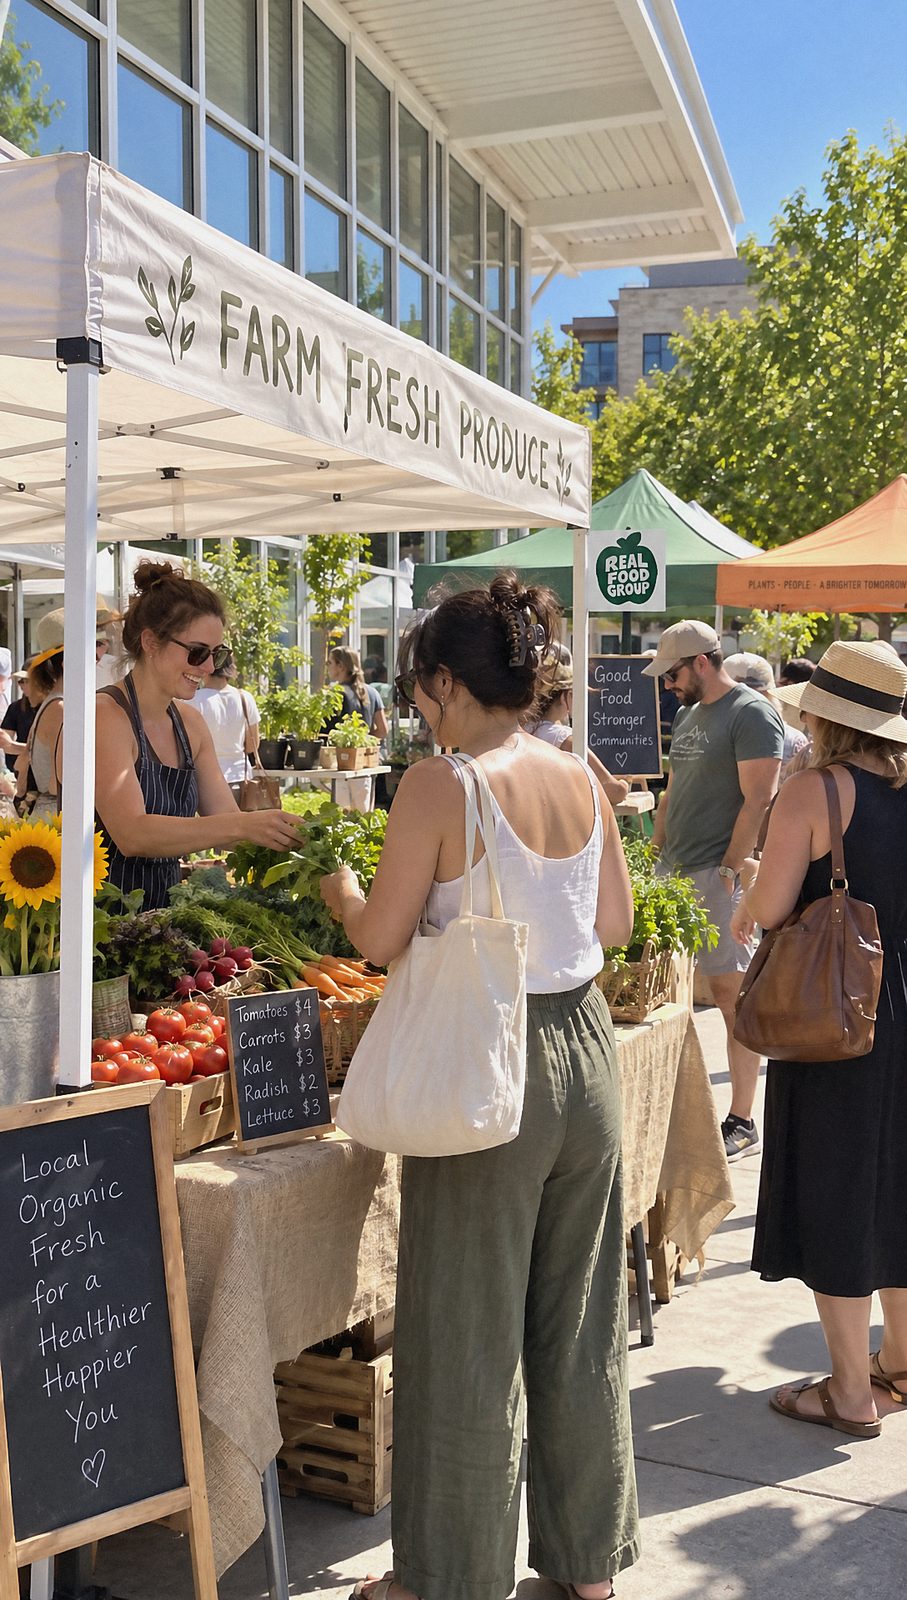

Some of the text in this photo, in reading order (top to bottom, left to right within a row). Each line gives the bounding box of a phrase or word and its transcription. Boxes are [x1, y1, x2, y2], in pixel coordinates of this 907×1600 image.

[219, 290, 549, 490] FARM FRESH PRODUCE
[605, 553, 648, 572] REAL
[607, 568, 650, 585] FOOD
[607, 581, 650, 598] GROUP
[748, 580, 907, 590] PLANTS PEOPLE A BRIGHTER TOMORROW
[594, 665, 632, 683] Good
[600, 688, 633, 706] Food
[592, 711, 646, 731] Stronger
[589, 733, 654, 747] Communities
[235, 997, 312, 1022] Tomatoes $4
[240, 1022, 312, 1049] Carrots $3
[243, 1048, 314, 1077] Kale $3
[244, 1073, 319, 1102] Radish $2
[247, 1098, 321, 1128] Lettuce $3
[21, 1139, 89, 1183] Local
[19, 1178, 123, 1227] Organic
[30, 1221, 105, 1267] Fresh
[31, 1274, 101, 1314] for a
[38, 1302, 152, 1356] Healthier
[42, 1345, 138, 1398] Happier
[65, 1401, 118, 1443] You
